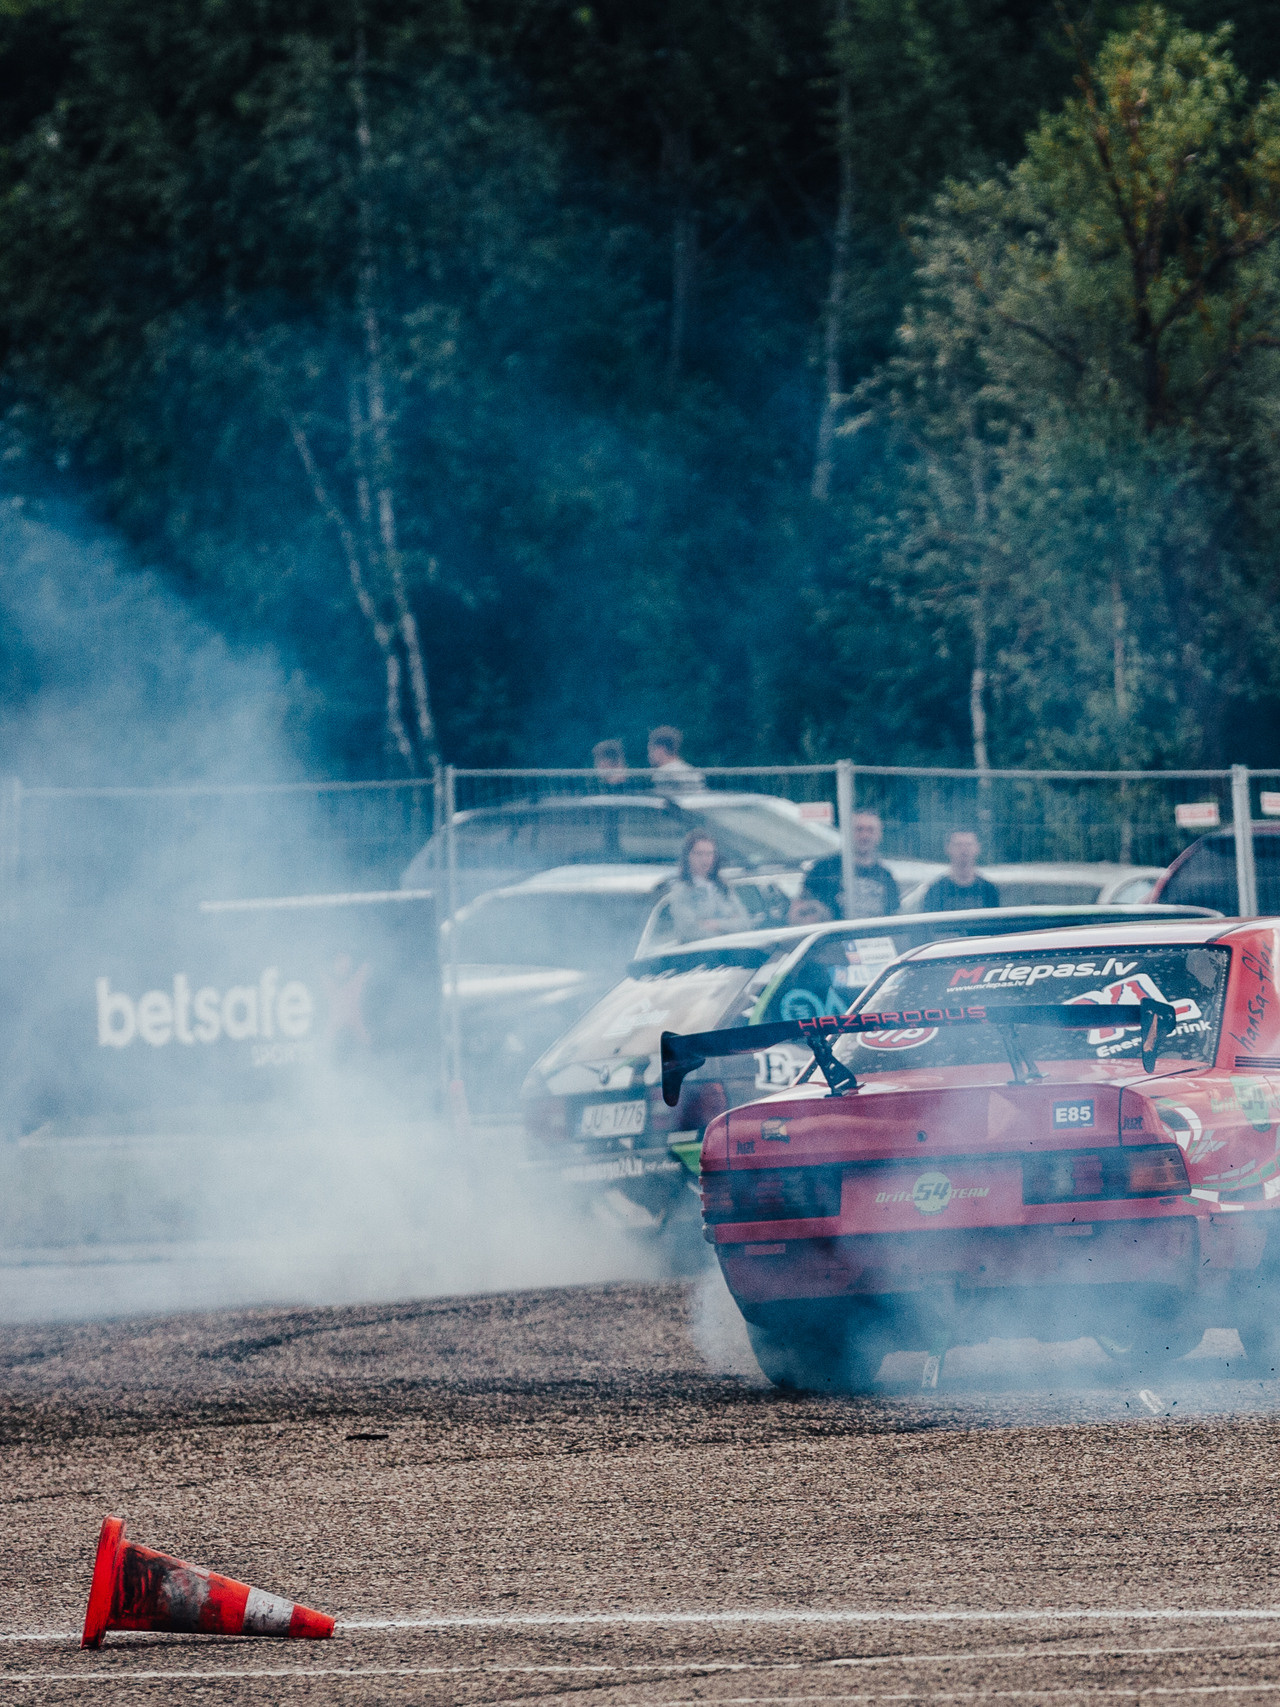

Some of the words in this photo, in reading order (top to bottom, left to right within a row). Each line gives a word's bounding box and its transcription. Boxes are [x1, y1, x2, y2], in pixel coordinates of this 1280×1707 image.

[950, 958, 1138, 986] Mriepas.lv
[96, 966, 312, 1049] belsafe
[799, 1006, 986, 1030] HAZARDOUS
[1096, 1037, 1142, 1058] Ener
[1055, 1106, 1091, 1123] E85
[914, 1181, 951, 1202] 54
[950, 1187, 991, 1200] TEAM
